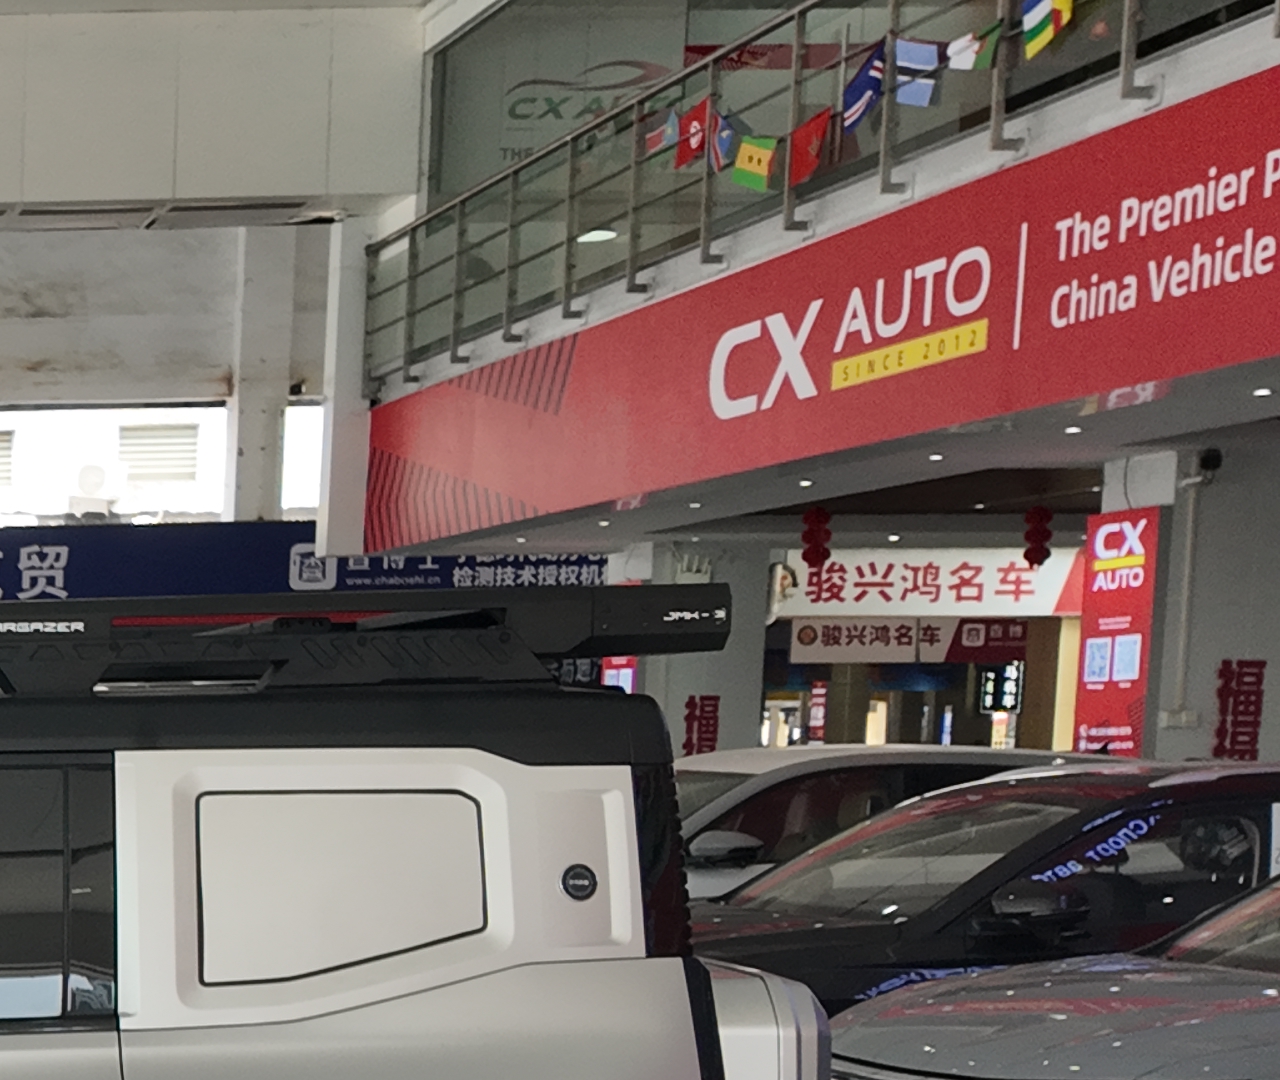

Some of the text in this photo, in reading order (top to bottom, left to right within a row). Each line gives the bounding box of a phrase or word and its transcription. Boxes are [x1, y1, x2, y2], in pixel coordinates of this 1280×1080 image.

[1055, 211, 1111, 261] The
[1118, 166, 1255, 243] Premier
[1050, 227, 1276, 328] China Vehicle
[709, 246, 991, 420] CX AUTO
[842, 329, 977, 382] SINCE 2012
[1094, 518, 1148, 560] CX
[805, 561, 1037, 603] 骏兴鸿名车
[1091, 566, 1144, 593] AUTO
[821, 624, 941, 647] 骏兴鸿名车
